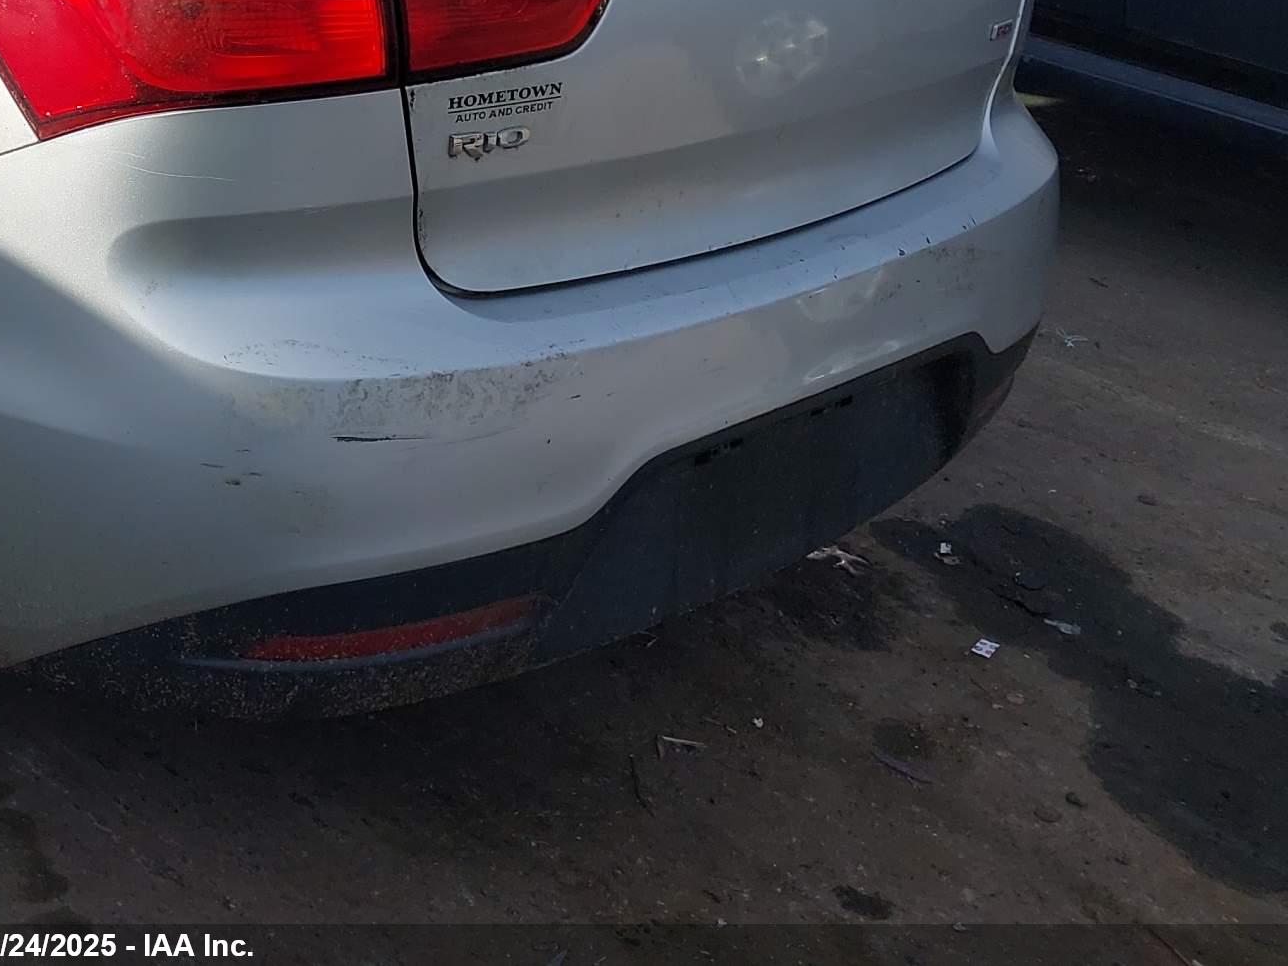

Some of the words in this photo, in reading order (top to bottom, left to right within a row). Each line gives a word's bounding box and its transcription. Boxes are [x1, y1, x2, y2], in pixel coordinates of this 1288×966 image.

[448, 82, 562, 109] HOMETOWN
[456, 111, 486, 123] AUTO
[488, 107, 513, 118] AND
[515, 101, 554, 114] CREDIT
[448, 126, 531, 161] RIO
